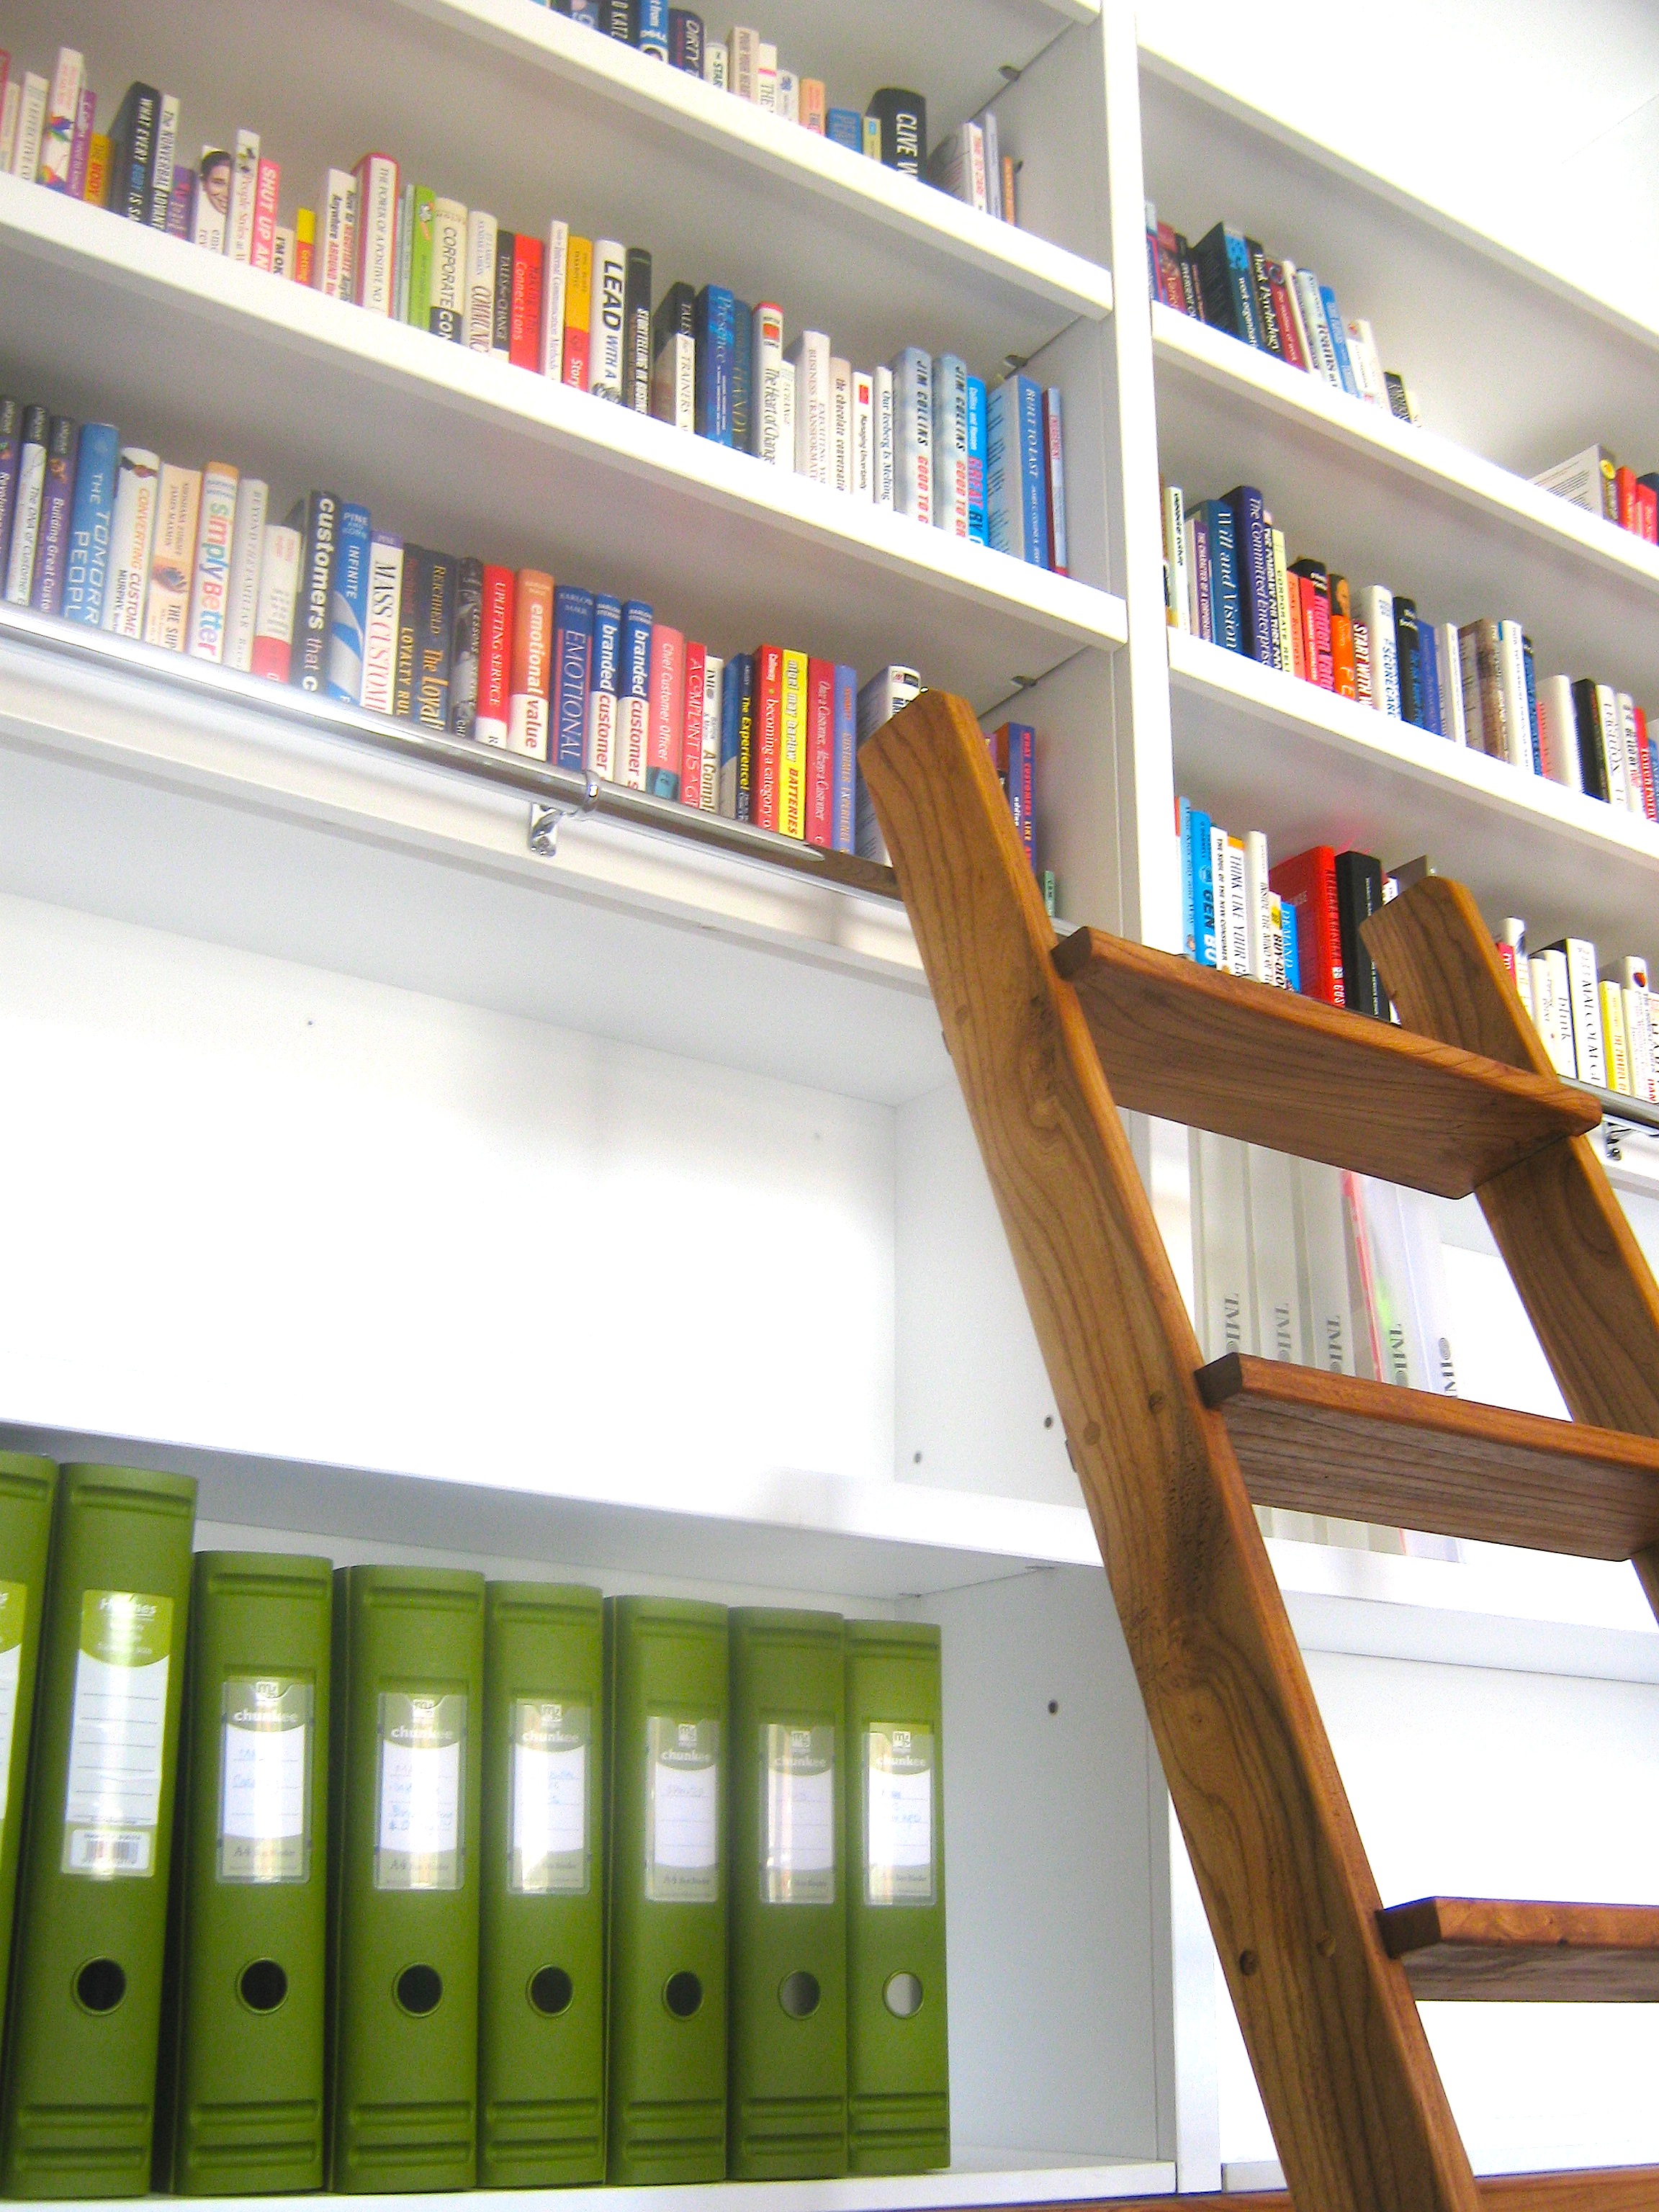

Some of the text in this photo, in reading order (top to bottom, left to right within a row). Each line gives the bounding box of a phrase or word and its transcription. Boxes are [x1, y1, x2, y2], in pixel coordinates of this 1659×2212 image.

[138, 98, 154, 128] WHAT
[896, 113, 919, 158] CLIVE
[133, 129, 150, 164] EVERY
[130, 192, 143, 205] IS
[260, 166, 276, 213] SHUT
[258, 216, 273, 242] UP
[438, 226, 457, 308] CORPORATE
[602, 260, 624, 379] LEAD WITH A
[716, 295, 732, 363] Presence
[570, 358, 584, 387] Story
[765, 368, 780, 385] The
[764, 388, 780, 413] Heart
[835, 394, 848, 436] chocolate
[881, 390, 892, 410] Our
[1025, 388, 1038, 426] BUILT
[879, 413, 893, 448] Iceberg
[917, 361, 929, 512] JIM COLLINS GOOD TO
[955, 365, 966, 517] JIM COLLINS GOOD TO
[881, 462, 894, 501] Melting
[967, 455, 984, 511] GREAT
[1027, 446, 1038, 480] LAST
[44, 498, 65, 577] Building Great
[968, 511, 983, 532] BY
[1249, 498, 1270, 597] The Committed
[84, 472, 110, 624] THE TOMORR
[124, 488, 150, 635] CONVERTING CUSTOME
[307, 498, 336, 631] customers
[345, 545, 361, 600] INFINITE
[64, 531, 91, 619] PEOPL
[115, 569, 129, 610] MURPHY
[372, 562, 397, 619] MASS
[1218, 512, 1240, 650] Will and Vision
[166, 605, 182, 624] THE
[303, 637, 323, 671] that
[397, 627, 414, 686] LOYALTY
[423, 649, 445, 673] The
[489, 582, 506, 706] UPLIFTING SERVICE
[1353, 624, 1372, 695] START WITH
[525, 605, 546, 748] emotional value
[559, 630, 587, 760] EMOTIONAL
[595, 624, 617, 771] branded customer
[628, 630, 649, 775] branded customer
[657, 642, 675, 762] Chief Customer Officer
[686, 658, 703, 770] A COMPLAINT IS
[761, 698, 779, 755] becoming
[702, 749, 716, 759] A
[738, 696, 752, 791] The Experience!
[760, 767, 775, 817] category
[787, 768, 799, 835] BATTERIES
[1202, 889, 1215, 928] GEN
[1230, 855, 1247, 959] THINK LIKE YOUR
[1282, 910, 1293, 968] DEMAND
[1557, 997, 1572, 1041] blink
[1581, 979, 1599, 1058] MALCOLM
[233, 1709, 296, 1722] chunkee
[391, 1726, 453, 1739] chunkee
[522, 1730, 579, 1742] chunkee
[662, 1748, 710, 1761] chunkee
[774, 1755, 827, 1768] chunkee
[876, 1755, 927, 1767] chunkee
